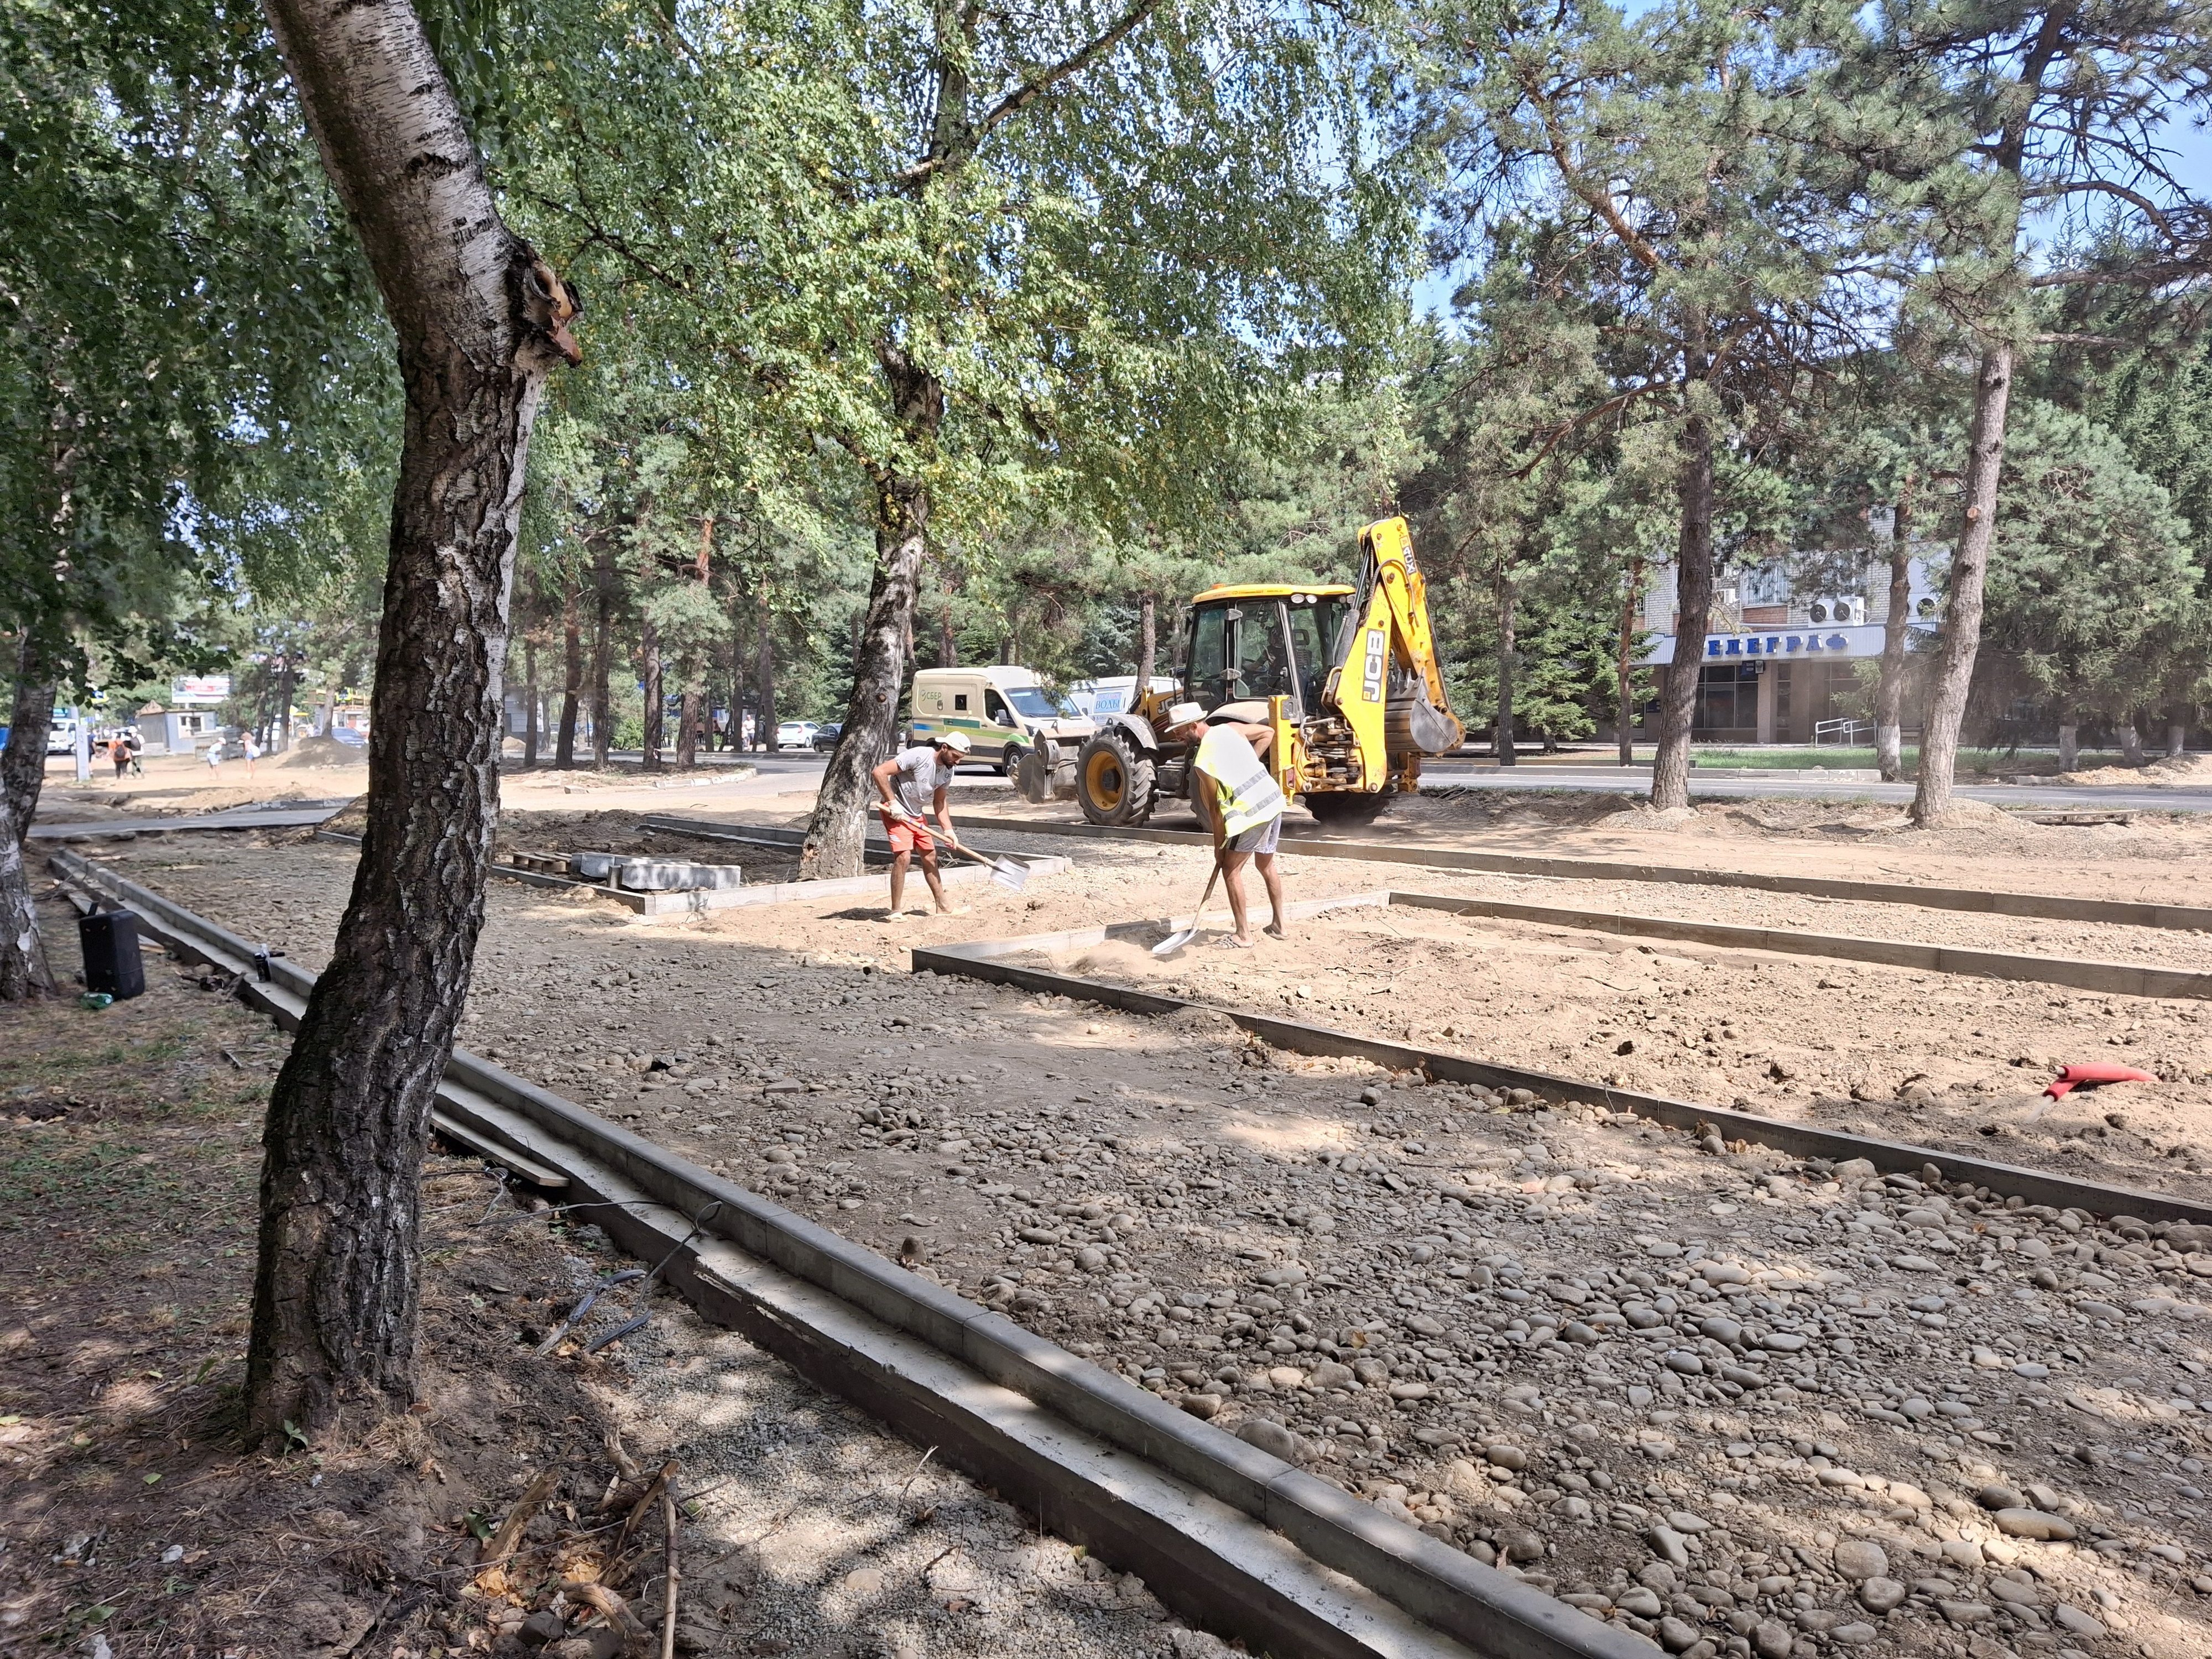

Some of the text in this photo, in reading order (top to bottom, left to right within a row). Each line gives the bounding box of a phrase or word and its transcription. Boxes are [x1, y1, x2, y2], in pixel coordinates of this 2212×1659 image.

[1704, 634, 1849, 655] ЕЛЕГРАФ
[1364, 630, 1384, 701] JCB
[926, 691, 942, 700] СБЕР
[1095, 700, 1120, 709] ВОДЫ
[1157, 693, 1184, 714] JCB
